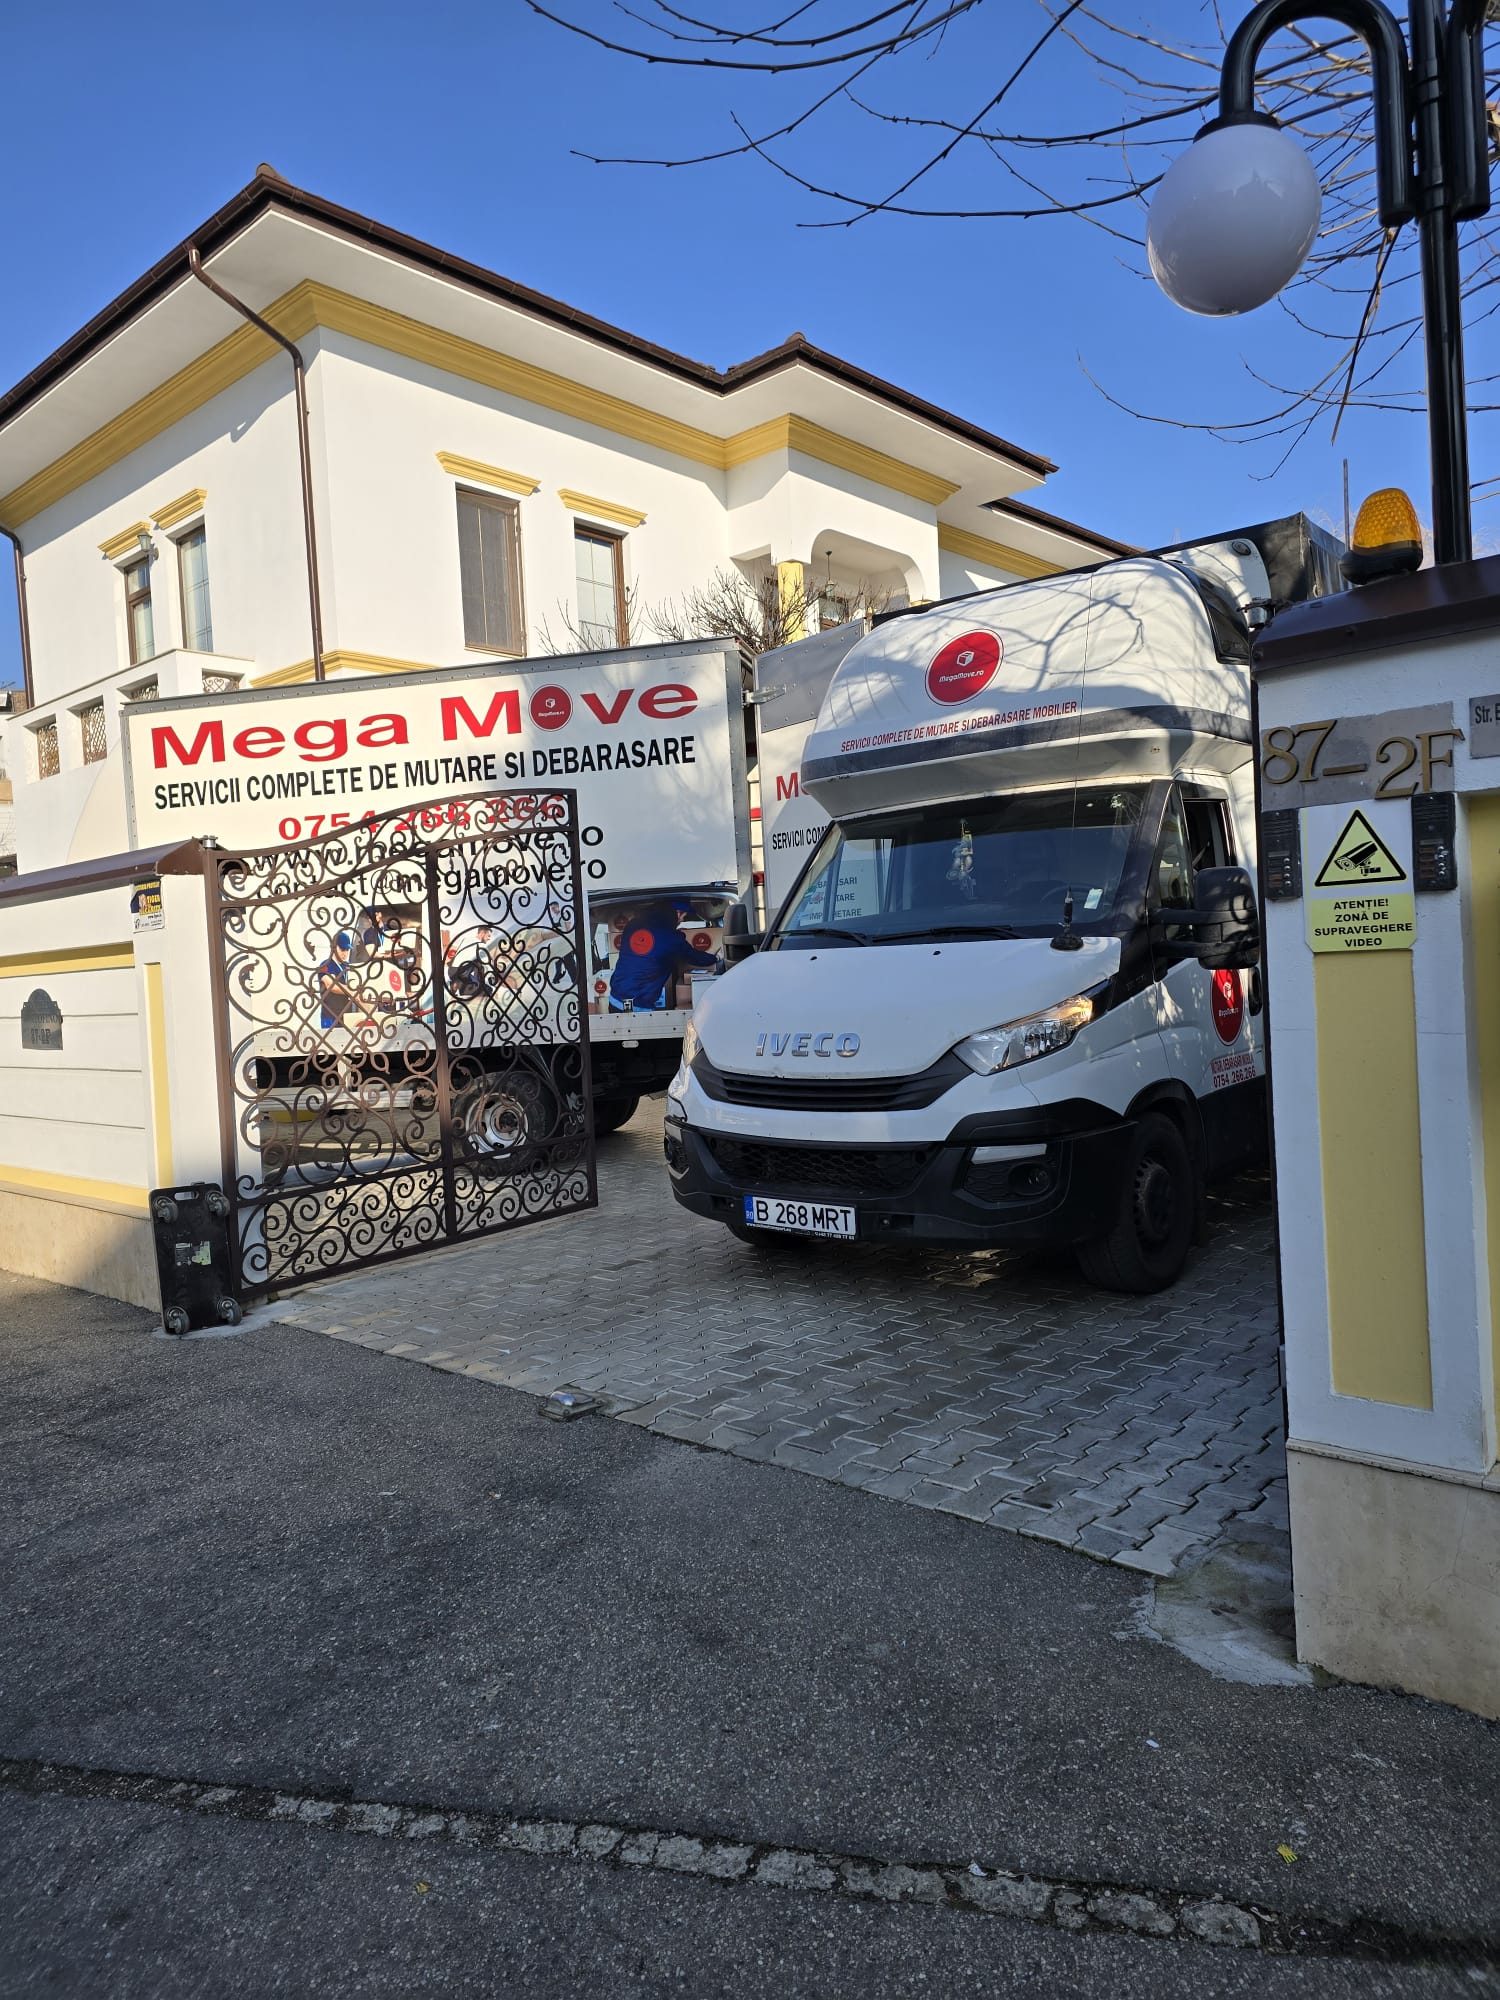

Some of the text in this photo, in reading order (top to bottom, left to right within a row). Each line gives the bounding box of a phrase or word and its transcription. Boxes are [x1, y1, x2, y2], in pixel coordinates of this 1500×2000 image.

[939, 670, 985, 683] MegaMove.ro
[841, 701, 1077, 753] SERVICII COMPLETE DE MUTARE SI DEBARASARE MOBILIER
[1475, 705, 1493, 724] Str.
[151, 713, 409, 769] Mega
[154, 736, 696, 810] SERVICII COMPLETE DE MUTARE SI DEBARASARE
[1261, 720, 1466, 800] 87-2F
[776, 772, 809, 801] M
[772, 829, 804, 850] SERVICII
[1372, 911, 1389, 920] DE
[1314, 923, 1413, 936] SUPRAVEGHERE
[1344, 937, 1382, 947] VIDEO
[755, 1032, 861, 1058] IVECO
[756, 1200, 769, 1222] B
[775, 1203, 808, 1227] 268
[812, 1206, 851, 1232] MRT
